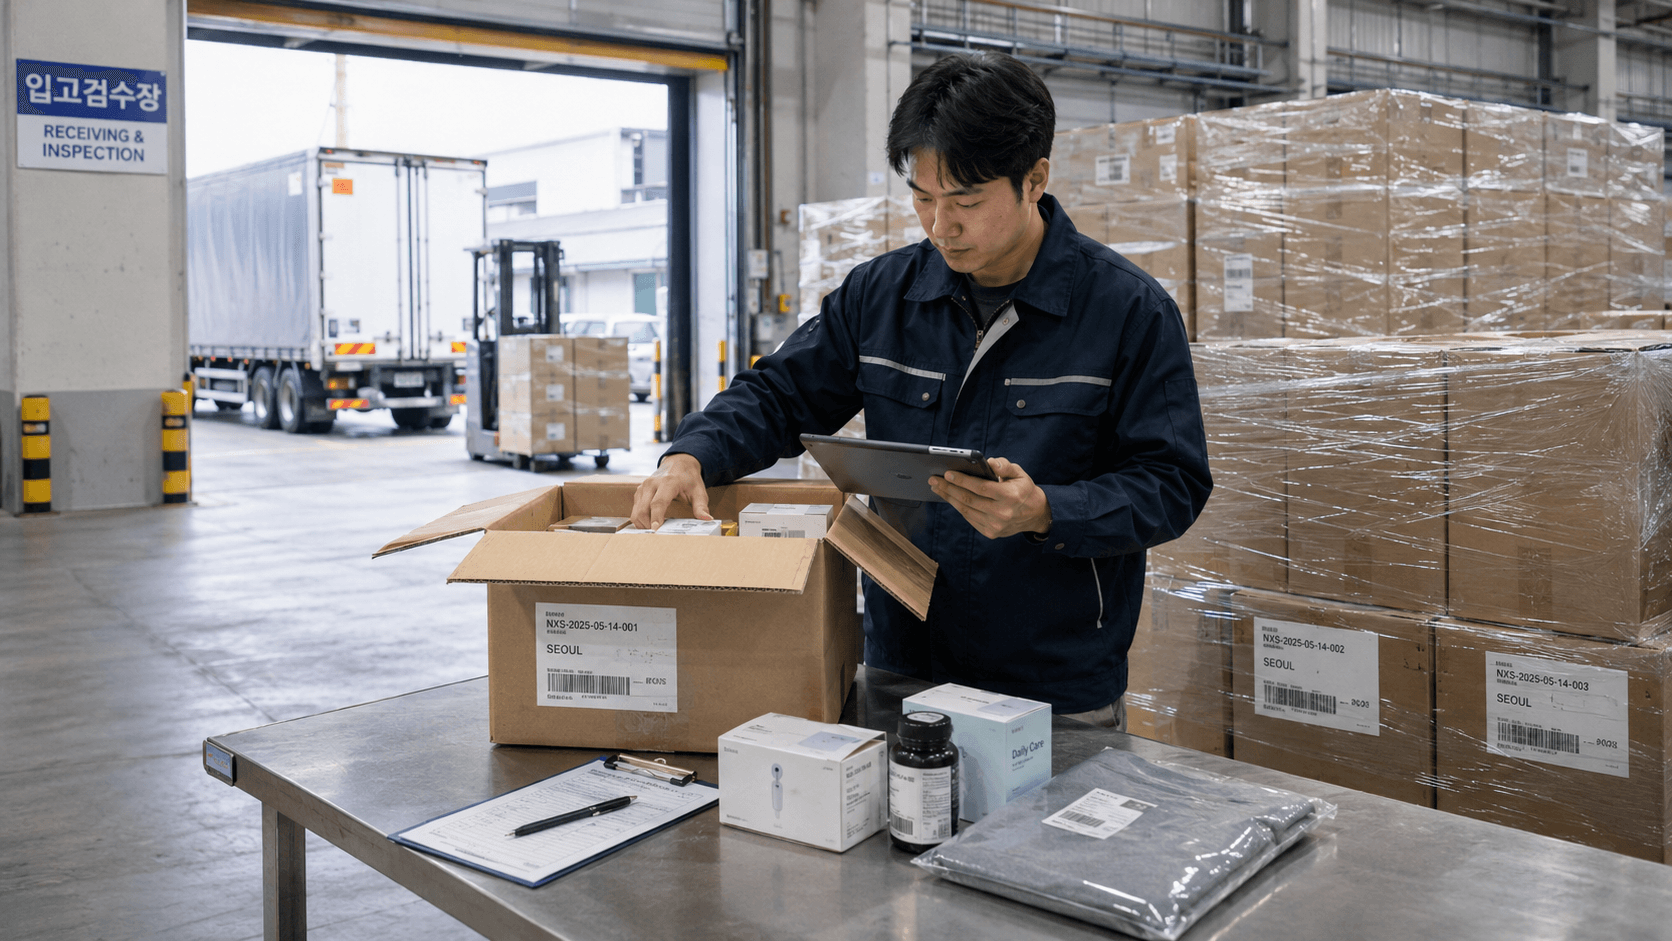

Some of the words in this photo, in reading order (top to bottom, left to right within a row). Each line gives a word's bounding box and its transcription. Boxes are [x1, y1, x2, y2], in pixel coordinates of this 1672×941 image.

[25, 73, 162, 112] 입고검수장
[44, 124, 130, 143] RECEIVING
[134, 130, 144, 144] &
[42, 143, 145, 162] INSPECTION
[546, 619, 638, 632] NXS-2025-05-14-001
[546, 644, 583, 655] SEOUL
[1263, 633, 1345, 654] NXS-2025-05-14-002
[1263, 657, 1295, 671] SEOUL
[1496, 669, 1589, 691] NXS-2025-05-14-003
[1496, 693, 1532, 708] SEOUL
[1012, 745, 1029, 760] Daily
[1029, 740, 1045, 752] Care
